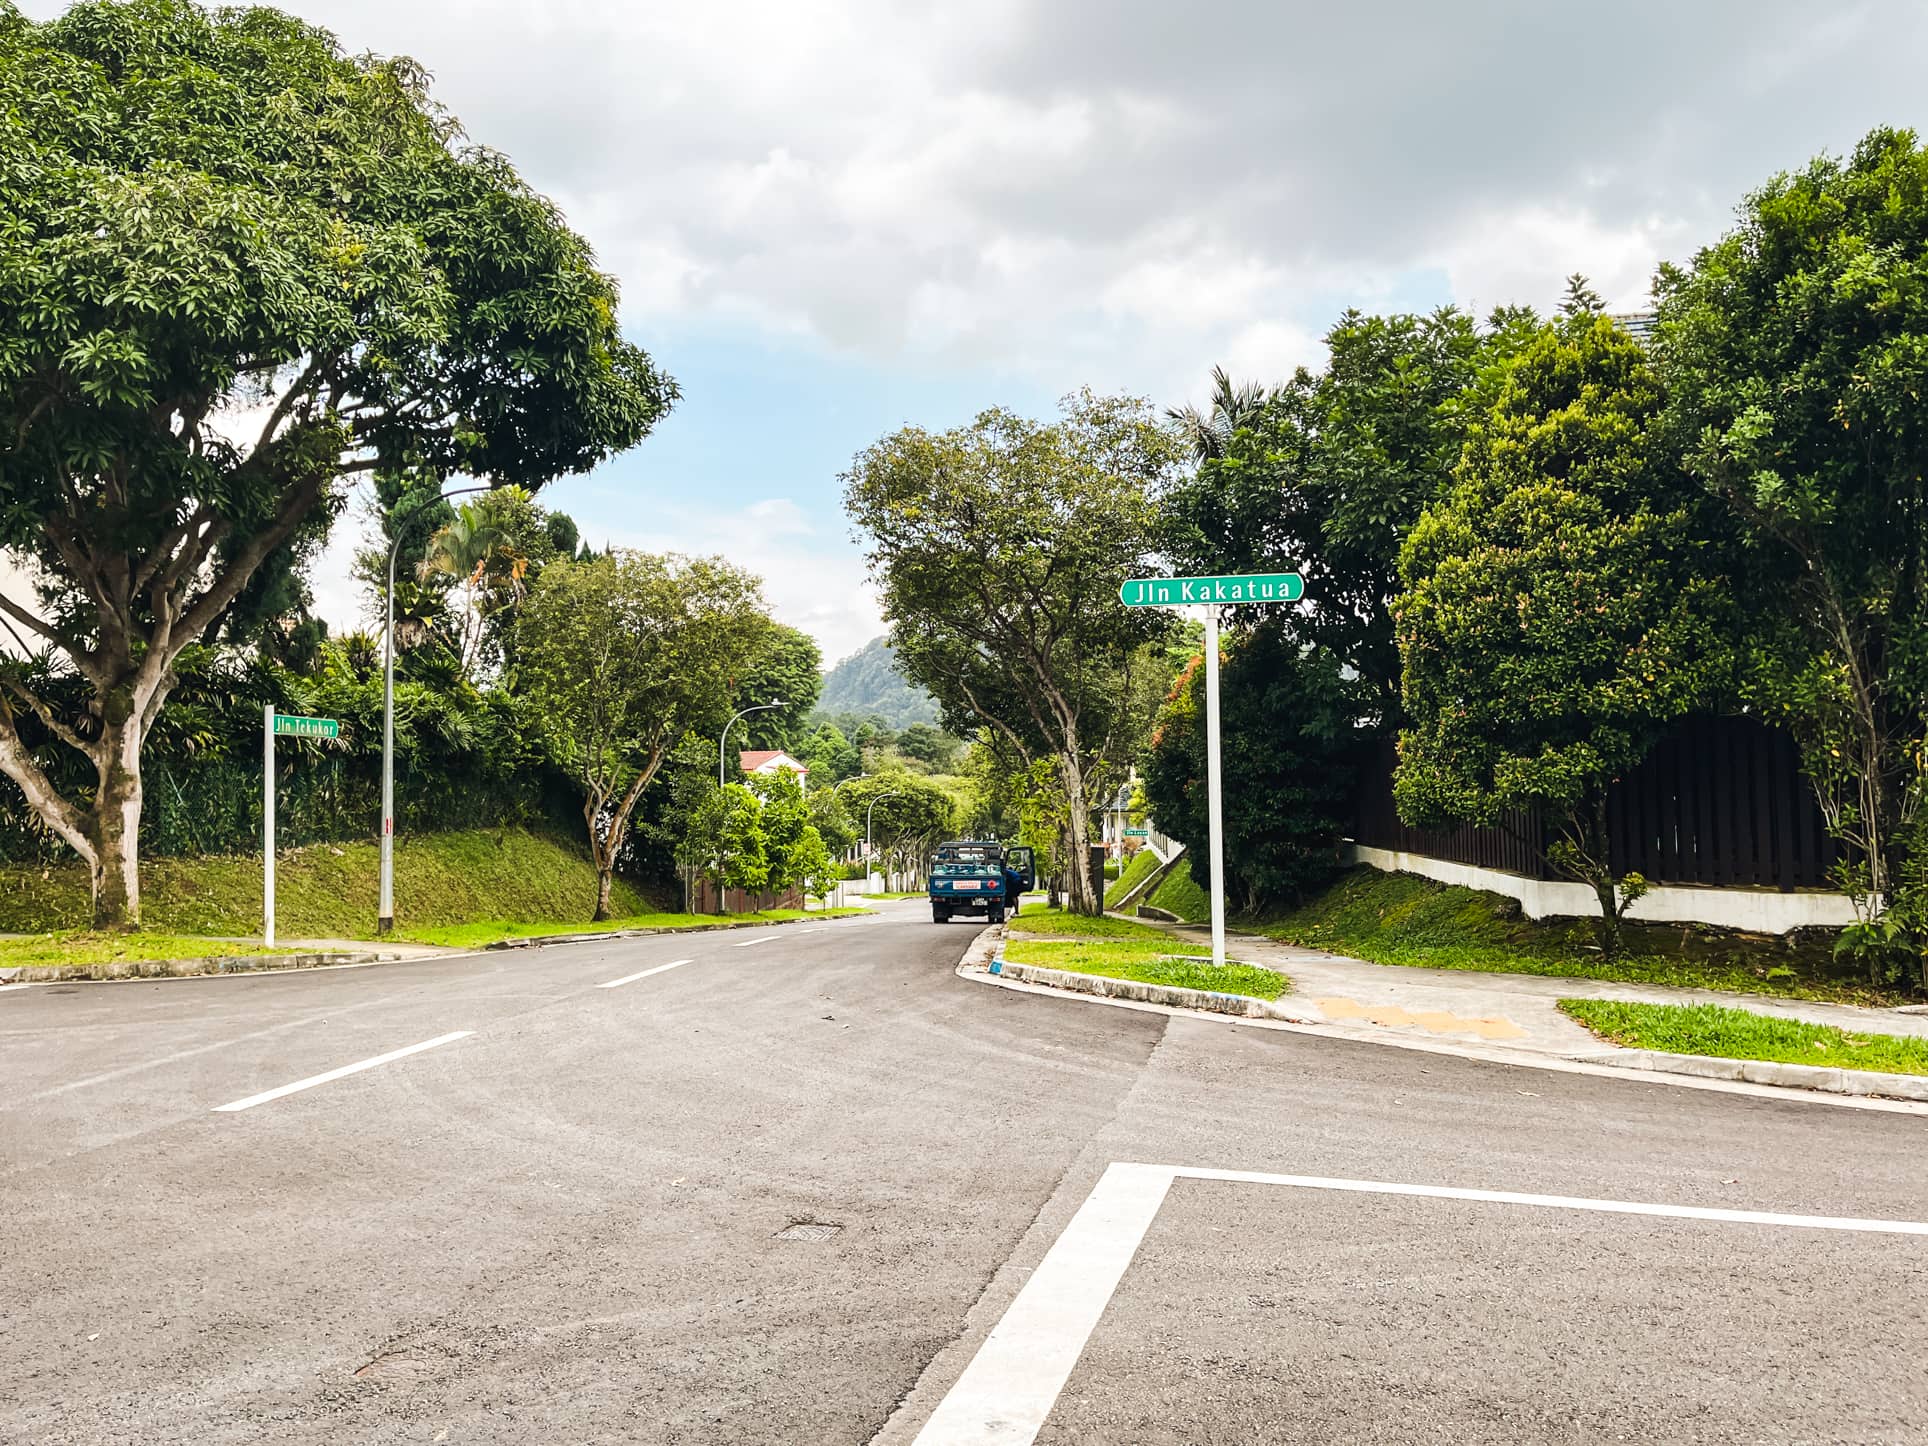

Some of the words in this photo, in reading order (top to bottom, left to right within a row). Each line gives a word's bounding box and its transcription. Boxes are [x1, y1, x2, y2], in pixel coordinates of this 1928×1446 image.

[1135, 583, 1169, 603] Jln
[1181, 580, 1289, 601] Kakatua
[275, 717, 291, 732] Jln
[295, 719, 333, 736] Tekukor
